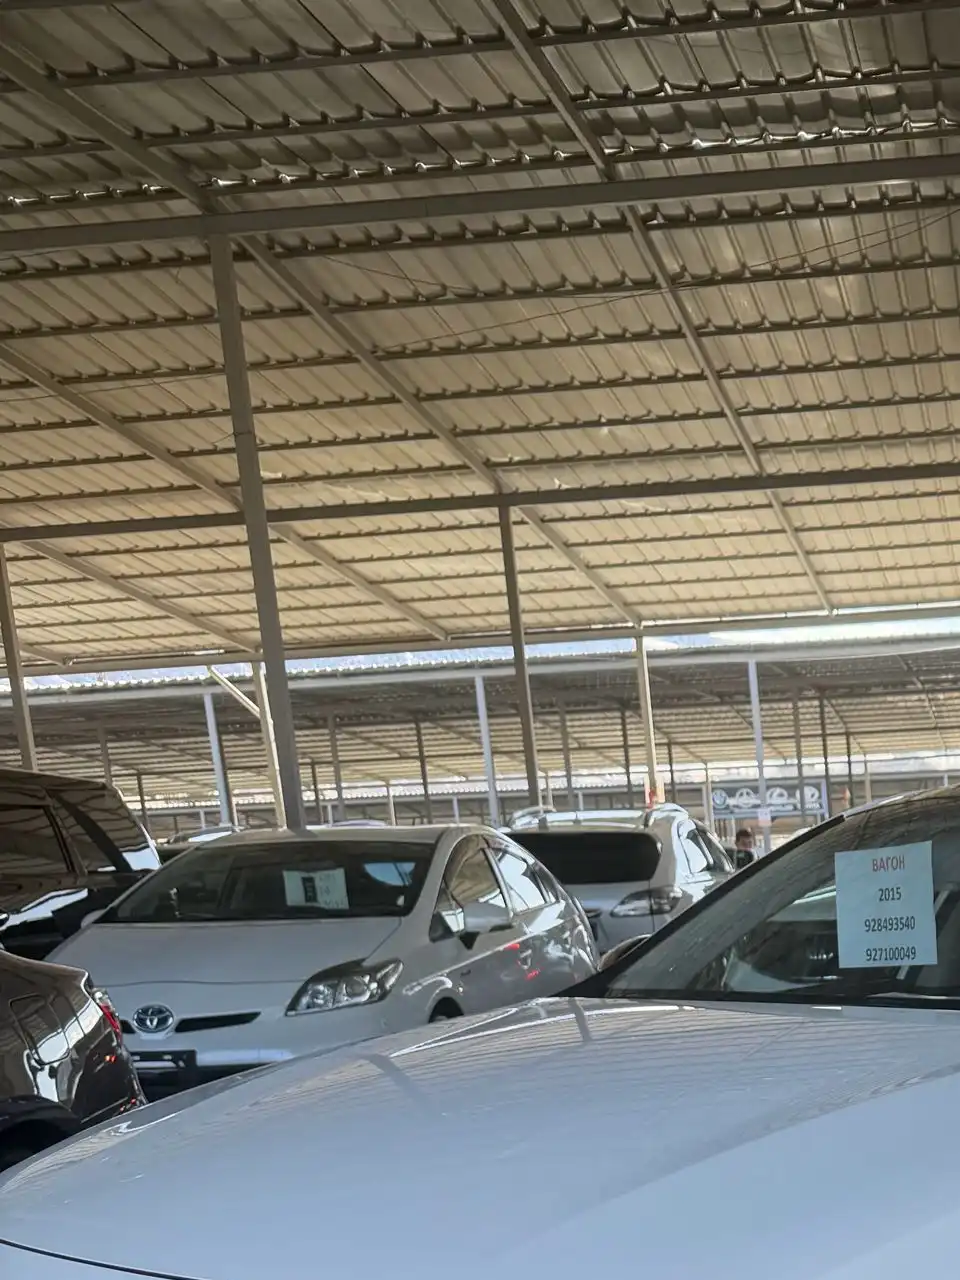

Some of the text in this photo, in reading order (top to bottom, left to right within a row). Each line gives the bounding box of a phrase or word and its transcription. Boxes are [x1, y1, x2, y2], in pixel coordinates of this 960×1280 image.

[872, 855, 905, 872] ВАГОН
[878, 887, 902, 901] 2015
[864, 916, 916, 932] 928493540
[865, 946, 917, 961] 927100049
